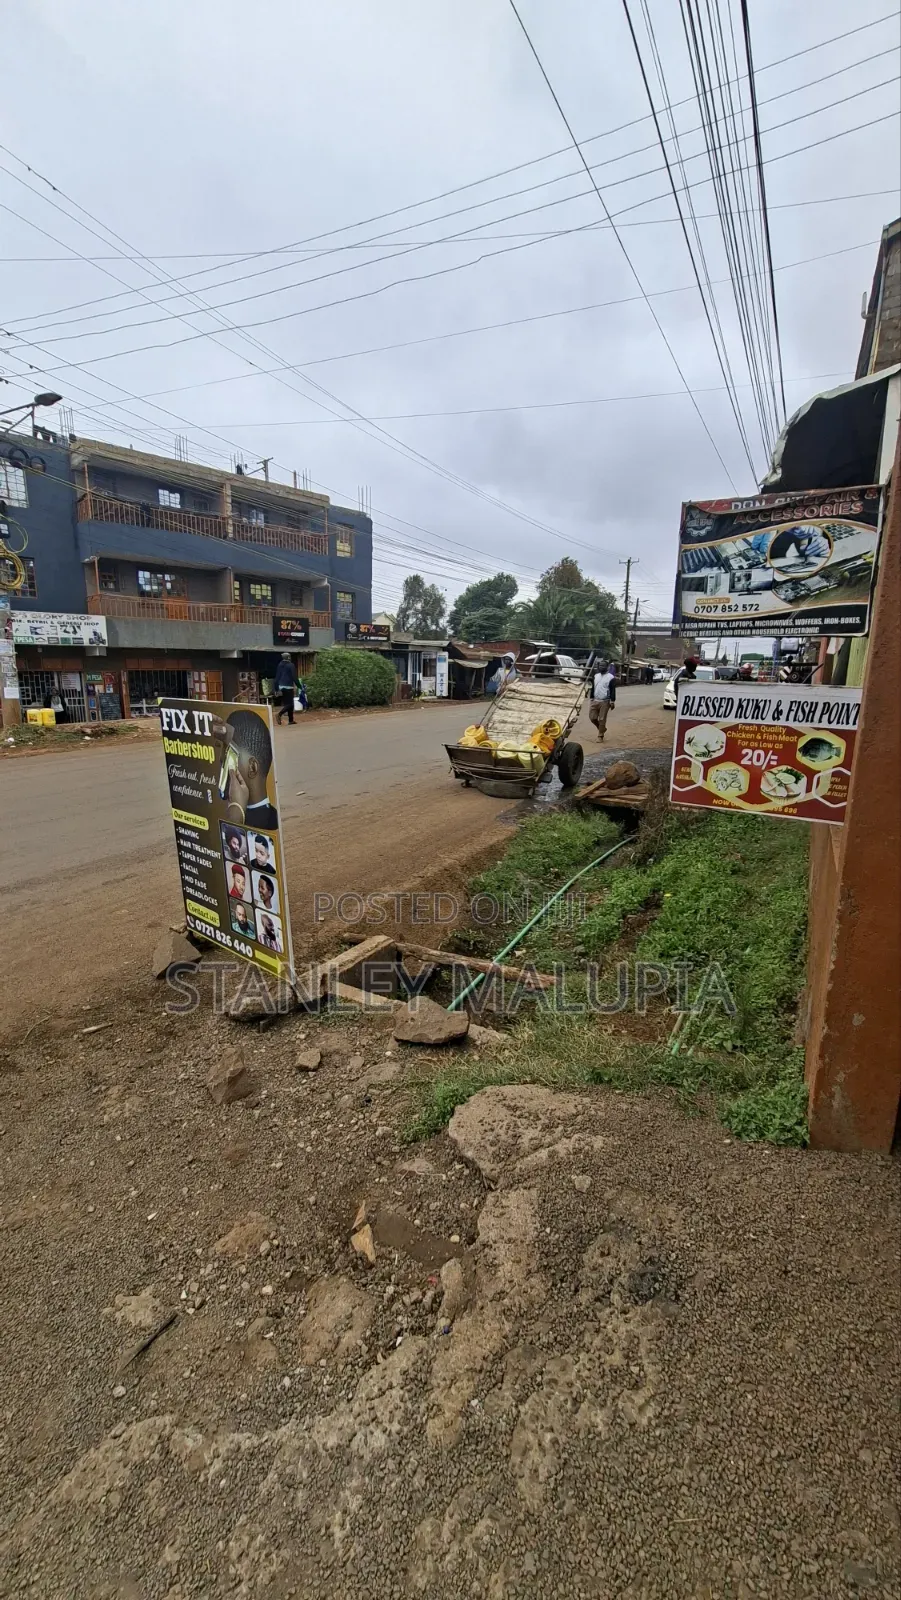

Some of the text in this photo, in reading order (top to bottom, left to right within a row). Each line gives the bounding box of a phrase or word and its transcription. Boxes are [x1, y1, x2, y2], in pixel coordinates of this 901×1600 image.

[733, 501, 864, 525] ACCESSORIES
[694, 603, 760, 614] 0707 852 572
[681, 696, 861, 726] BLESSED KUKU & FISH POINT
[160, 707, 212, 736] FIX IT
[760, 725, 787, 734] Quality
[727, 731, 755, 739] Chicken
[778, 734, 798, 742] Meat
[163, 736, 215, 764] Barbershop
[740, 748, 779, 770] 20/=
[168, 763, 187, 779] Fresh
[173, 810, 206, 827] Our services
[178, 826, 200, 839] SHAVING
[180, 838, 221, 860] HAIR TREATMENT
[181, 850, 213, 869] TAPER FADES
[182, 862, 199, 875] FACIAL
[184, 874, 207, 890] MID FADE
[185, 886, 218, 906] DREADLOCKS
[187, 902, 209, 920] Contact
[195, 919, 254, 958] 0721 826 440
